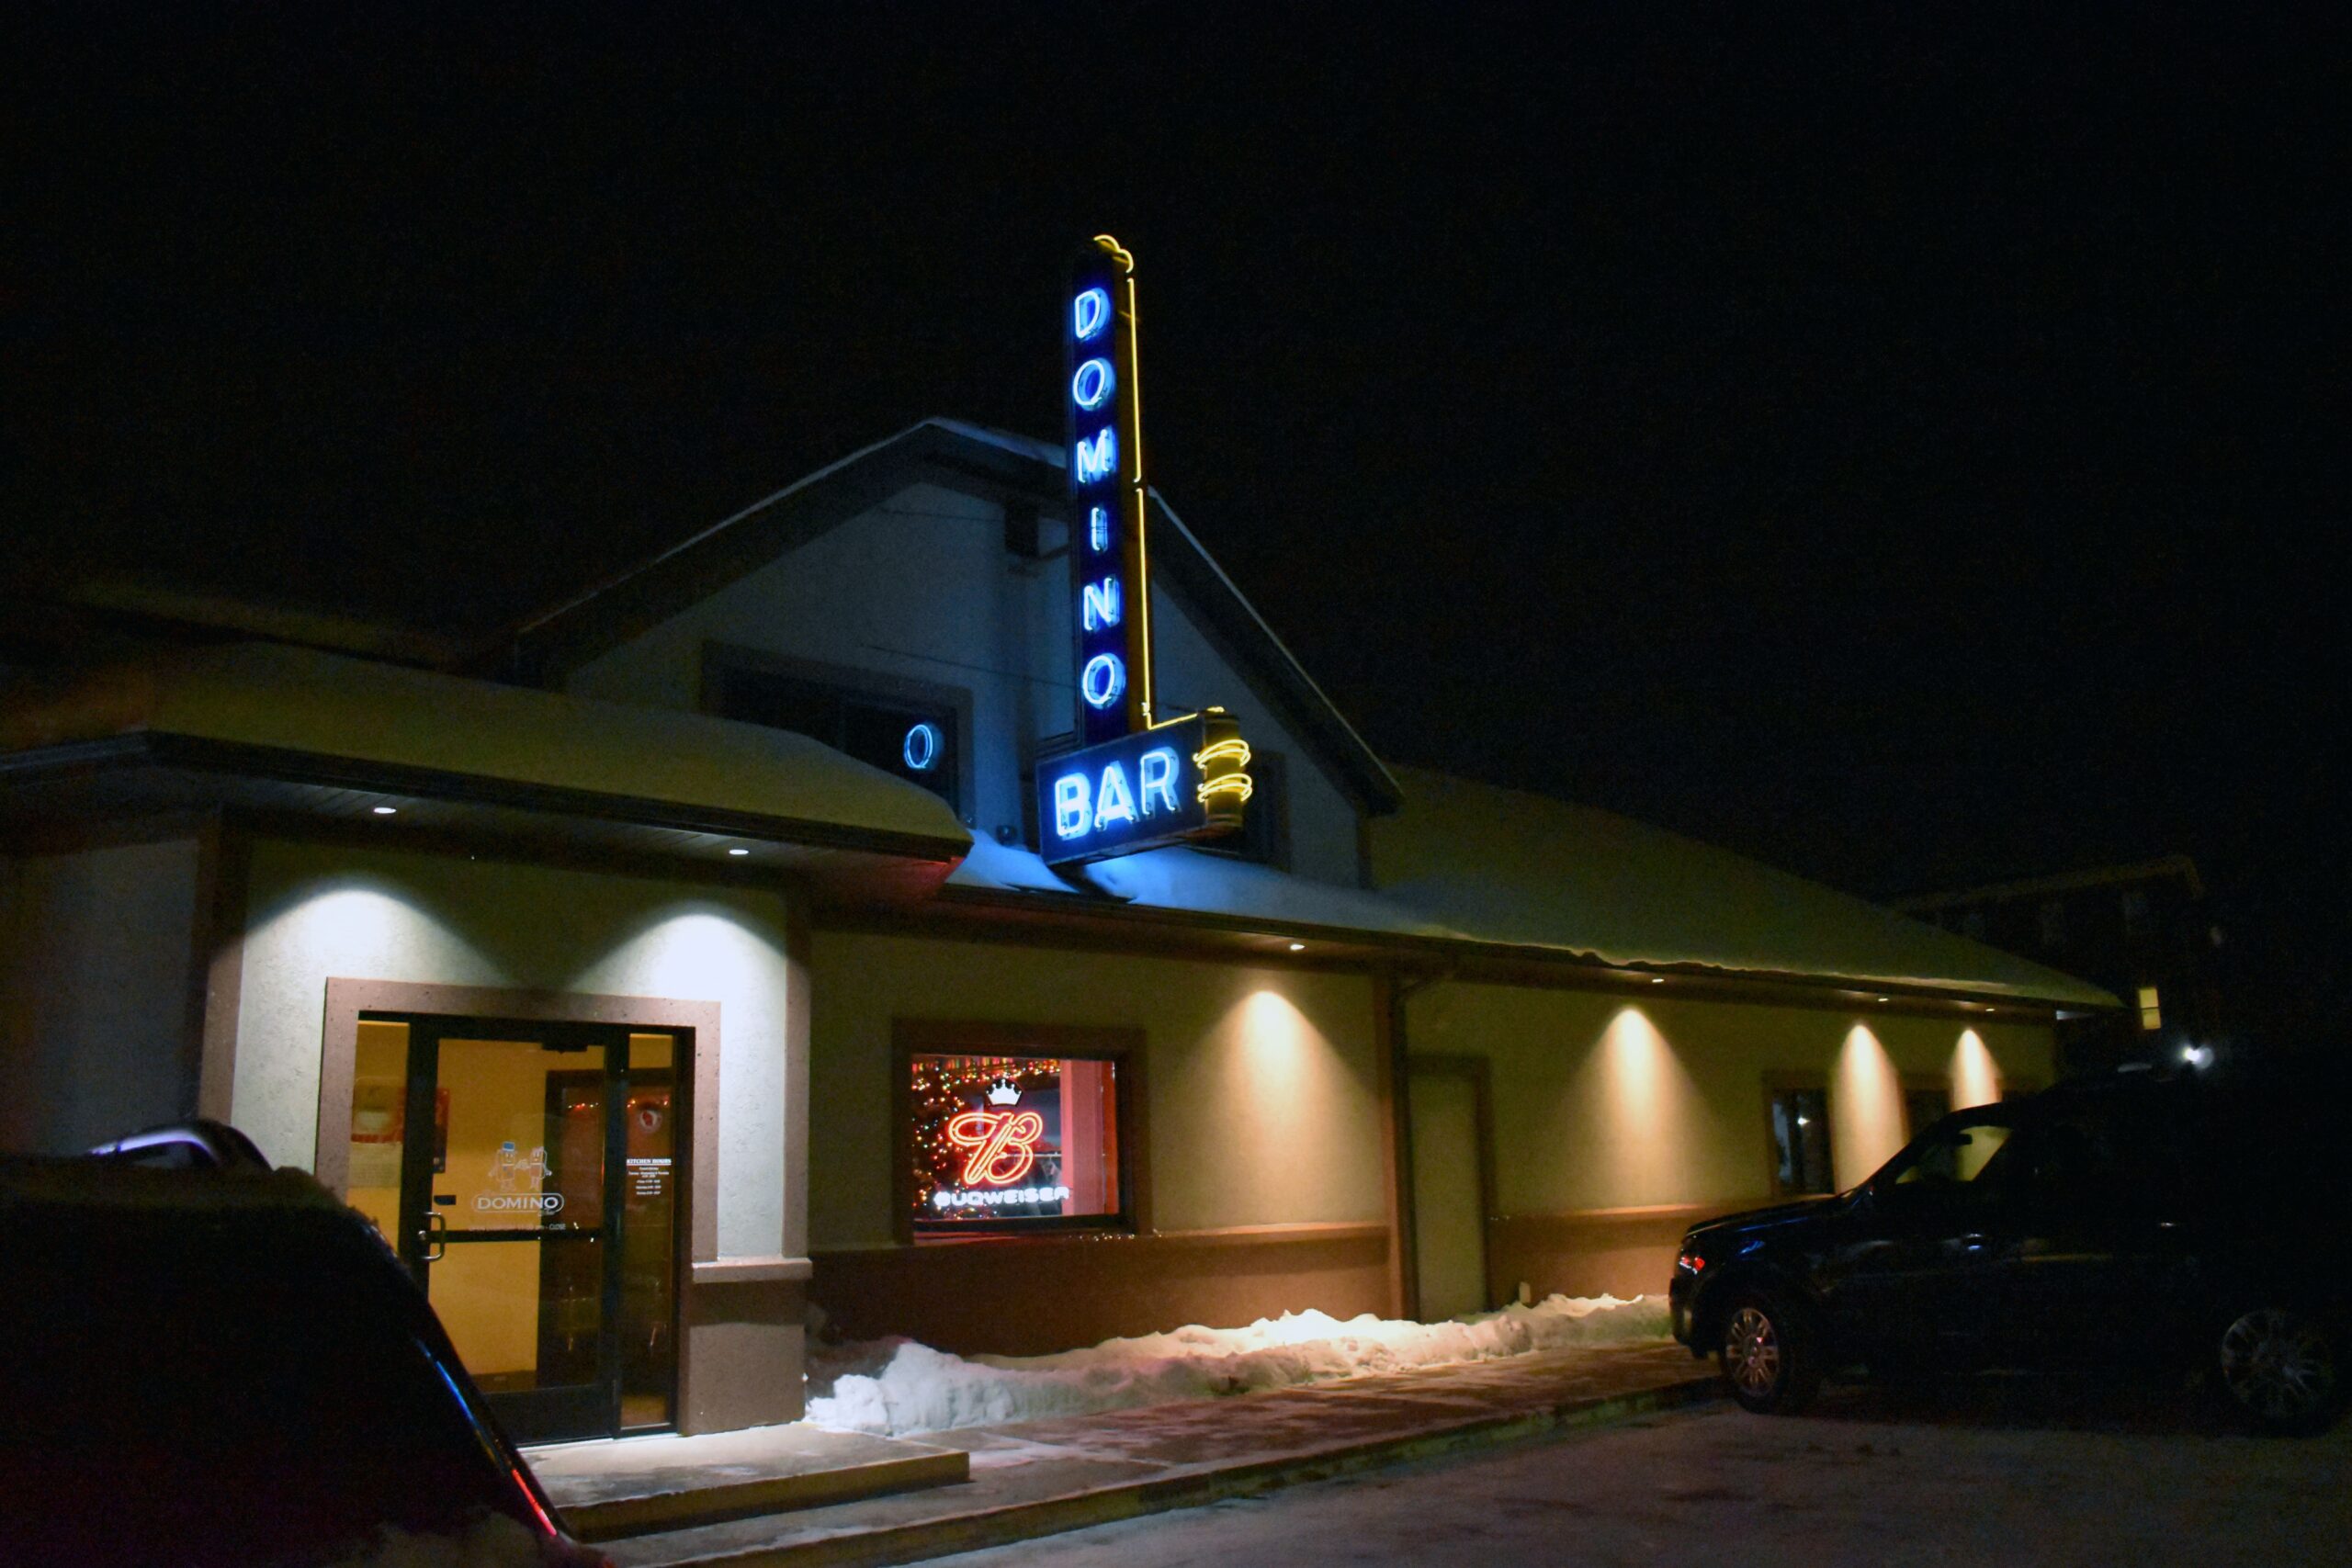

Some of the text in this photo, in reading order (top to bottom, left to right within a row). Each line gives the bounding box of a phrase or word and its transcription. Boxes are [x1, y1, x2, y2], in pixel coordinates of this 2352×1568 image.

[1072, 286, 1126, 710] DOMINO
[1054, 746, 1181, 841] BAR
[478, 1197, 559, 1210] DOMINO
